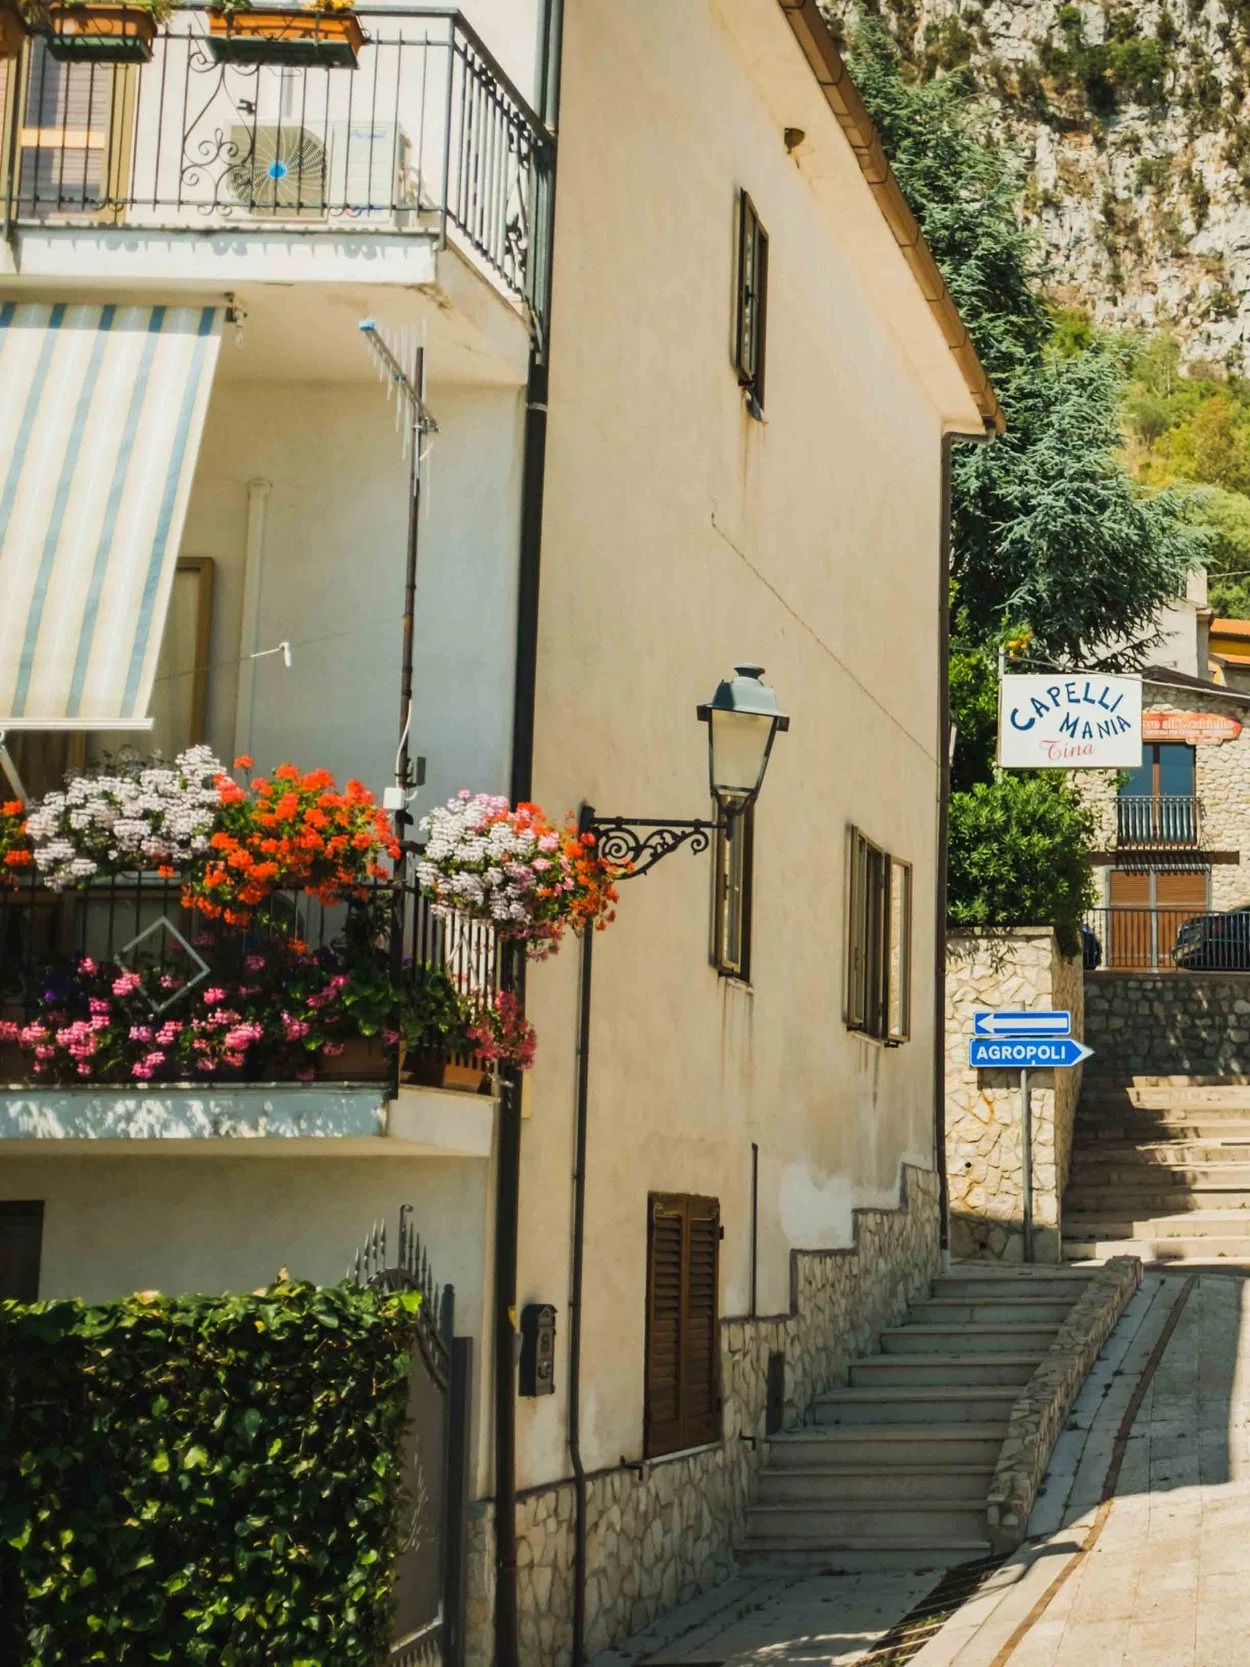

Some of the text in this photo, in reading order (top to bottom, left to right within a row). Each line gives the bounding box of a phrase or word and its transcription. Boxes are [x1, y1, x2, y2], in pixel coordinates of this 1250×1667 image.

[1010, 682, 1124, 731] CAPELLI
[1059, 711, 1131, 739] MANIA
[1039, 739, 1095, 761] Tina
[976, 1045, 1066, 1060] AGROPOLI
